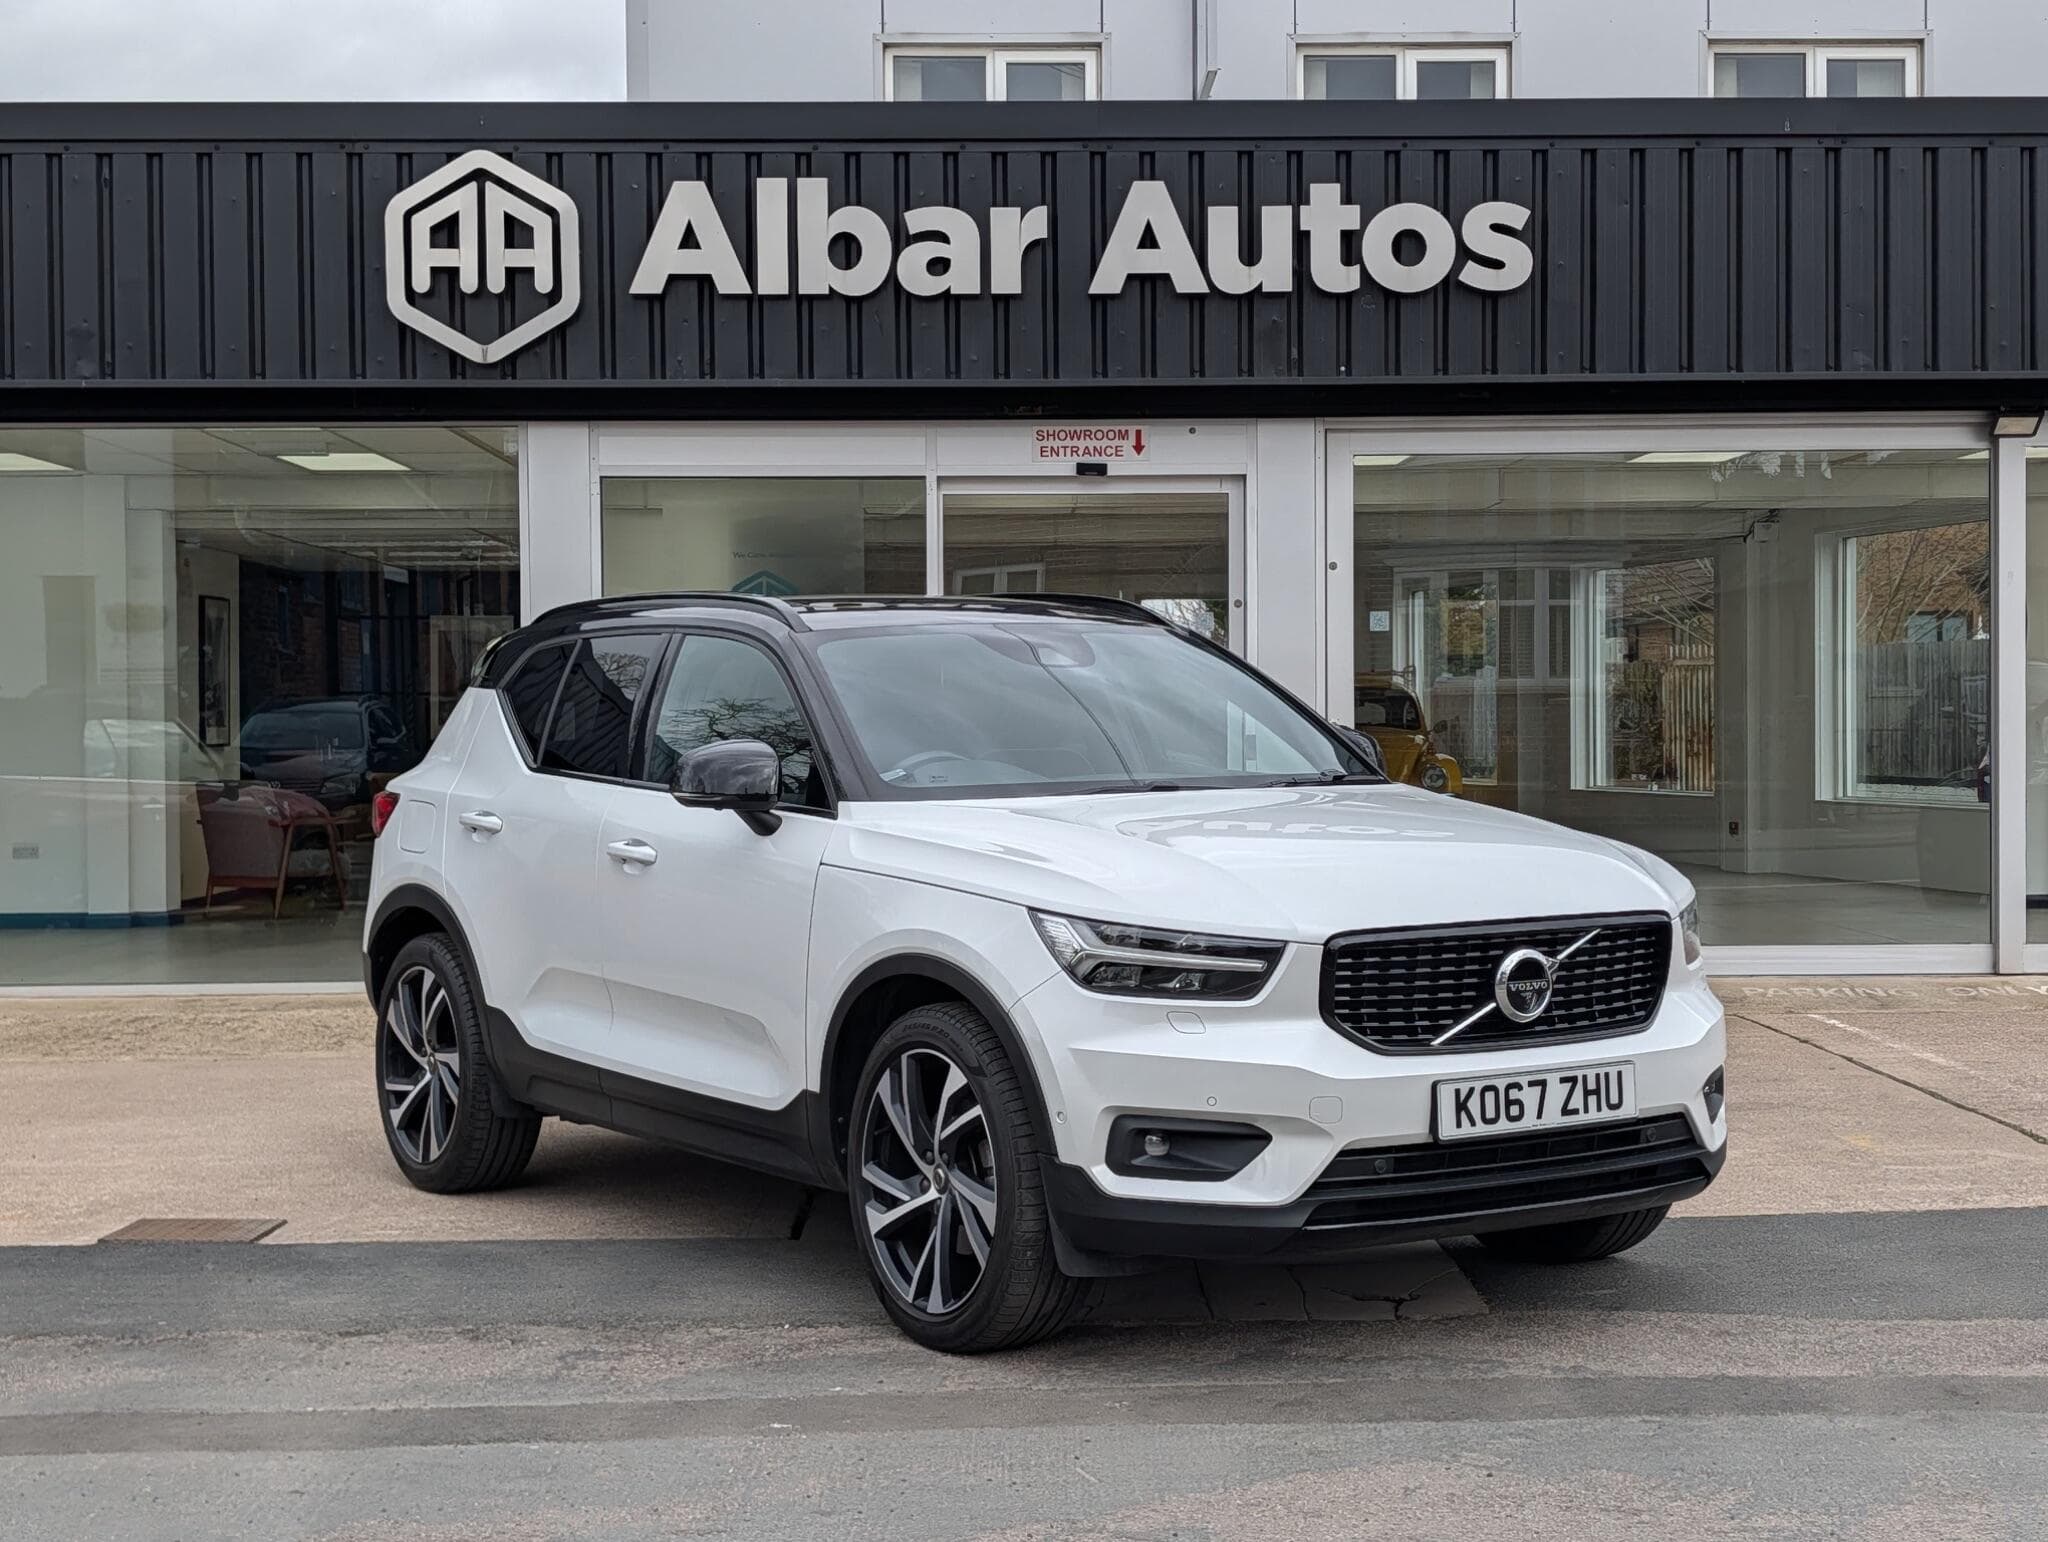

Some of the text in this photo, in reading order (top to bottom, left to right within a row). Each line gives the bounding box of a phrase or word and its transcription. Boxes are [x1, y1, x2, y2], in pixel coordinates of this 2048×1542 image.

[629, 176, 1534, 297] Albar Autos
[1035, 428, 1130, 442] SHOWROOM
[1039, 444, 1124, 458] ENTRANCE
[1508, 981, 1548, 992] VOLVO
[1559, 1069, 1624, 1117] ZHU
